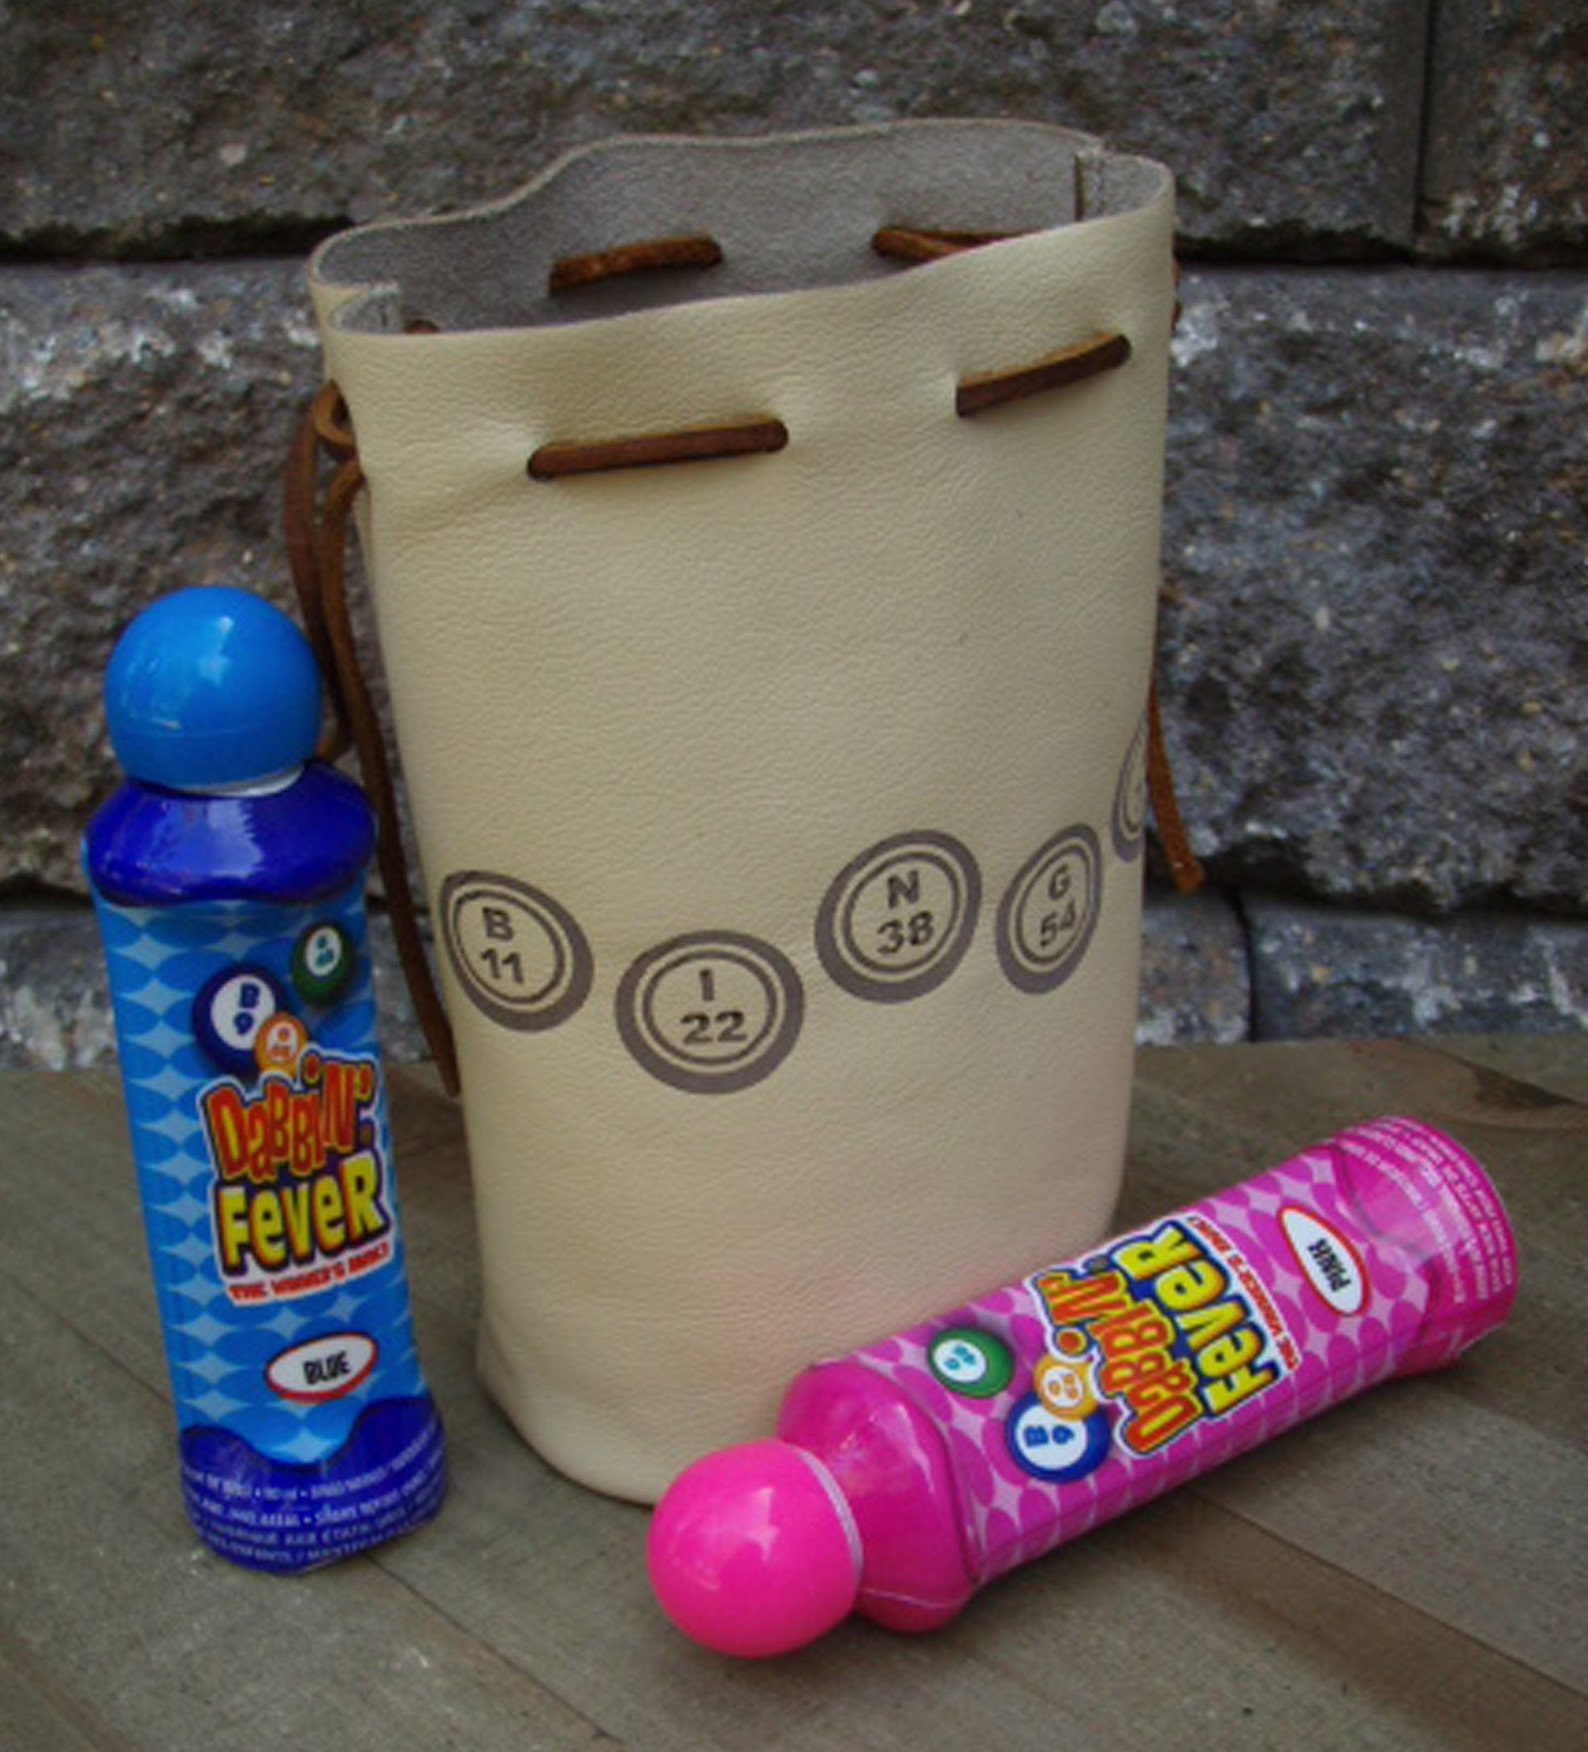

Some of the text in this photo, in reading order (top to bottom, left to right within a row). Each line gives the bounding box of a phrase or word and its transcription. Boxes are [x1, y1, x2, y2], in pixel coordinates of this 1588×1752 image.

[886, 869, 921, 909] N
[1048, 863, 1071, 900] G
[482, 906, 515, 942] B
[876, 910, 934, 954] 38
[1039, 900, 1077, 948] 54
[480, 948, 524, 985] 11
[699, 968, 716, 1002] I
[680, 1010, 748, 1045] 22
[303, 1350, 352, 1385] BLUE
